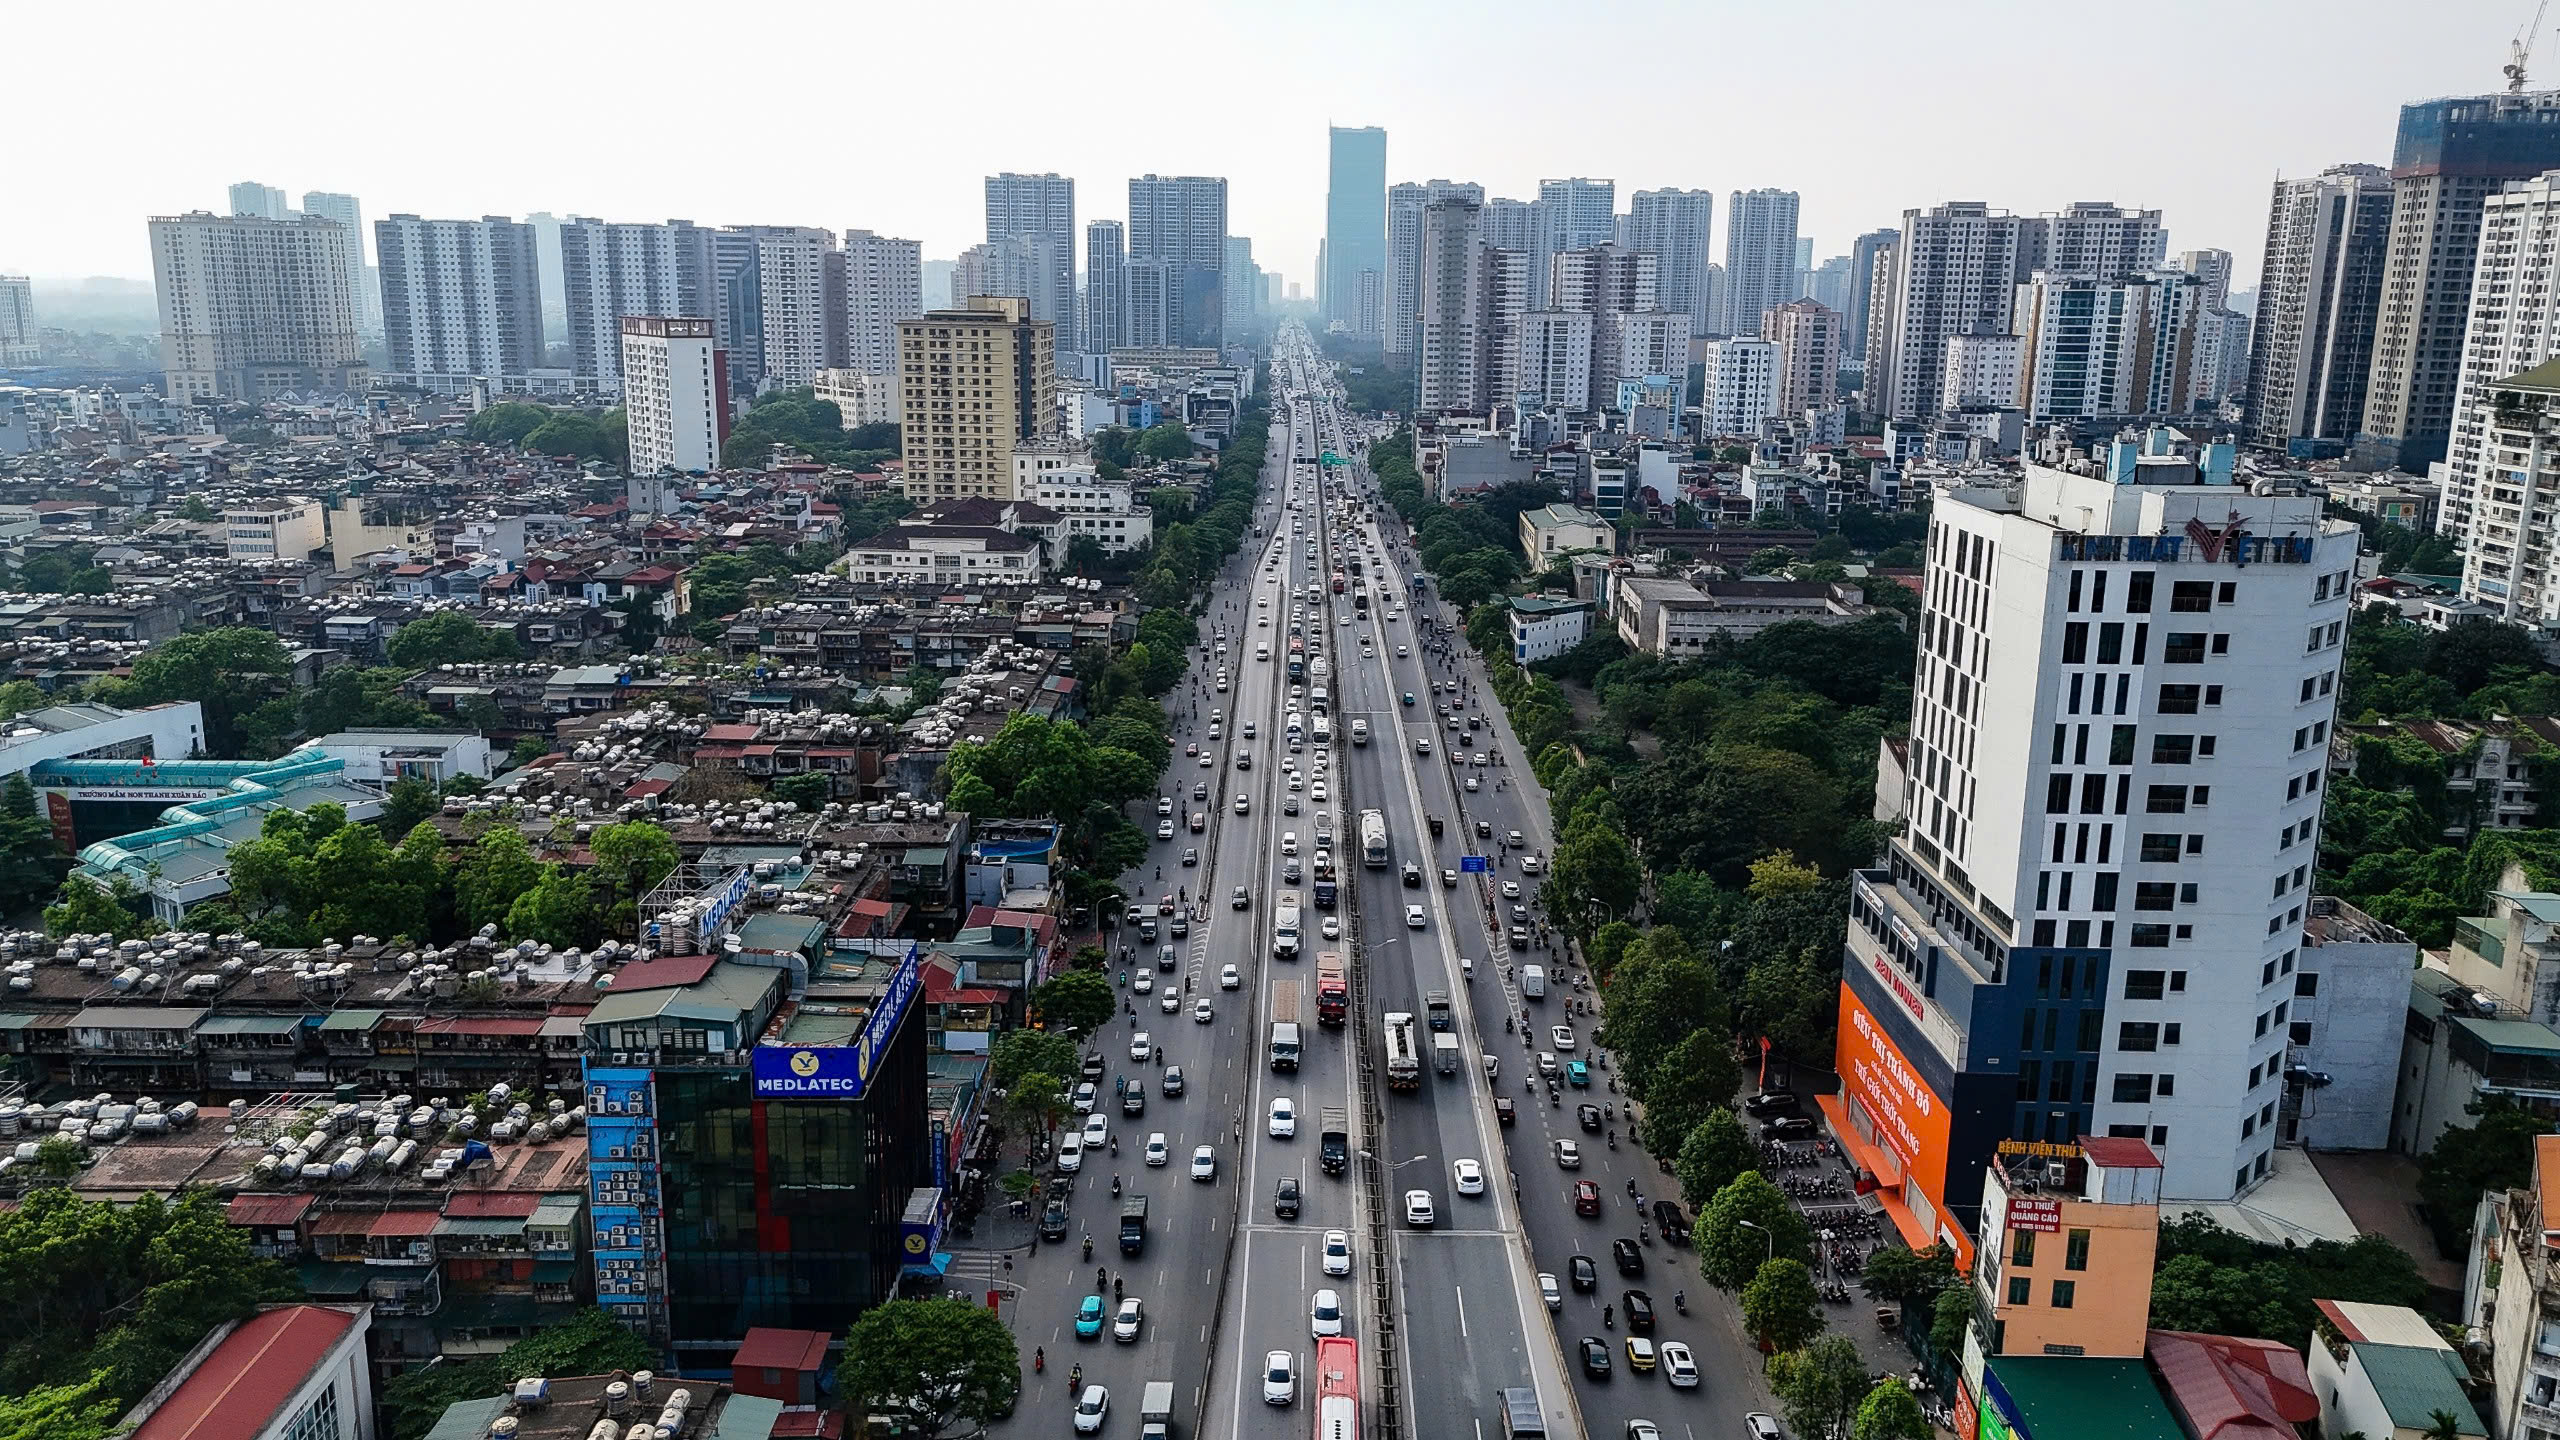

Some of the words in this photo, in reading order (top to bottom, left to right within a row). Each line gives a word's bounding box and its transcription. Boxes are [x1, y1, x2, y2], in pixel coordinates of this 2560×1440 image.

[700, 869, 749, 938] MEDLATEC
[872, 956, 916, 1054] MEDLATEC
[1893, 974, 1924, 1022] TOWER
[758, 1078, 854, 1091] MEDLATEC
[1897, 1116, 1920, 1156] TRANG
[934, 1132, 943, 1187] MEDLATE
[2010, 1209, 2039, 1221] QUẢNG
[2040, 1211, 2059, 1223] CÁO
[2015, 1200, 2033, 1210] CHO
[2034, 1200, 2056, 1211] THUÊ
